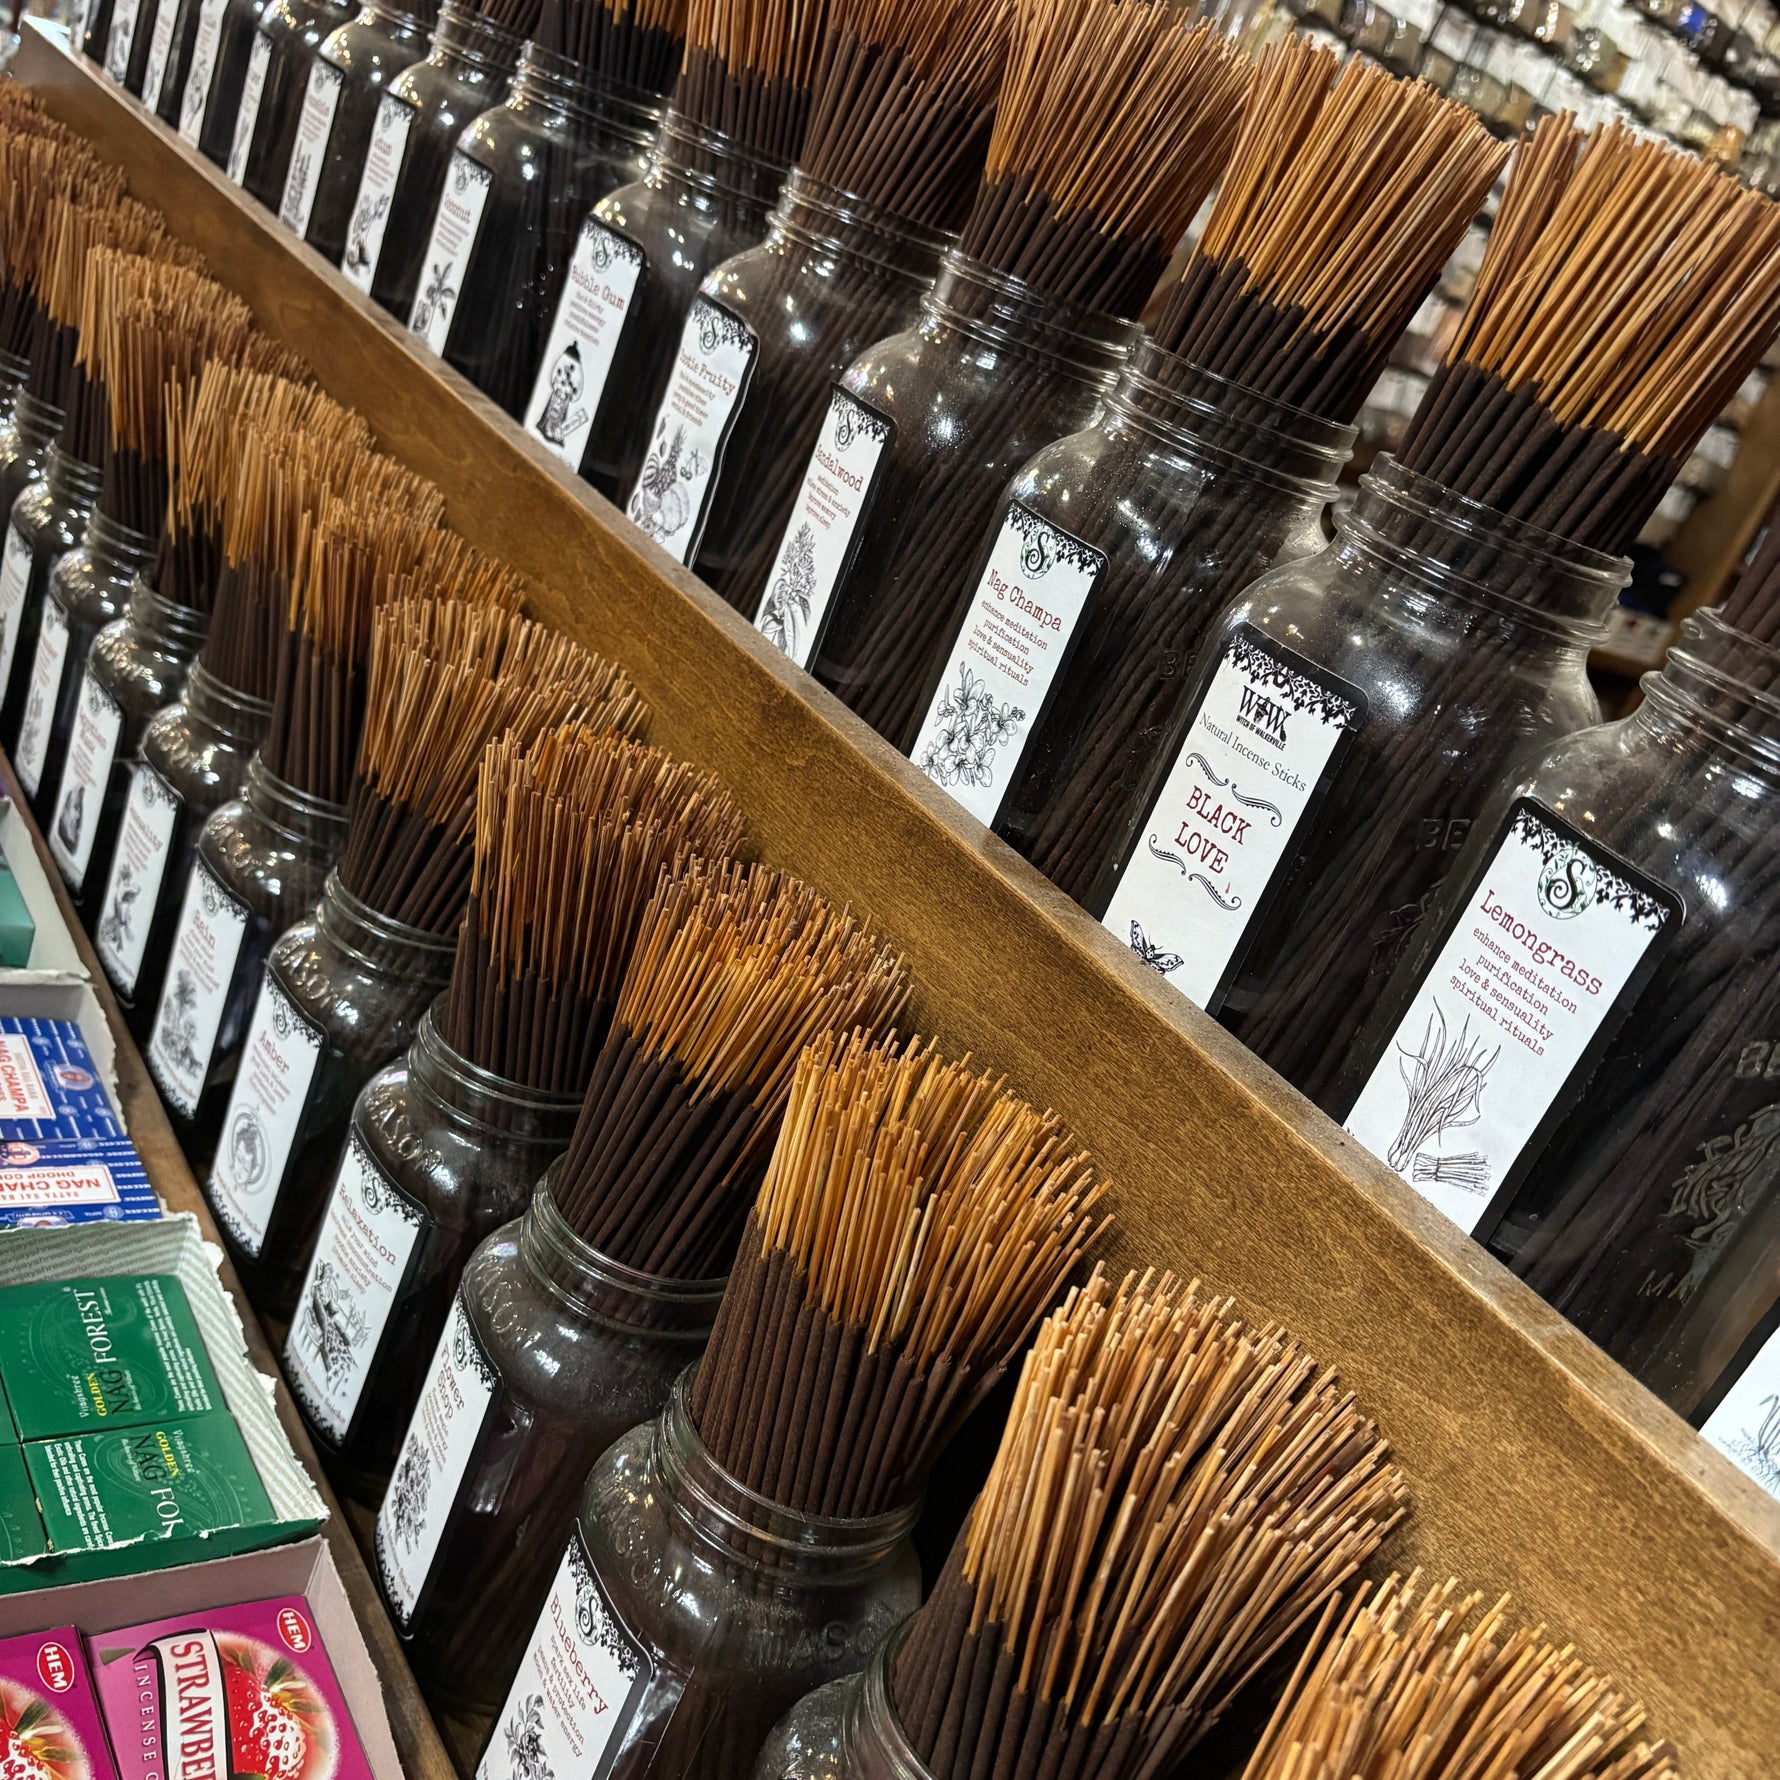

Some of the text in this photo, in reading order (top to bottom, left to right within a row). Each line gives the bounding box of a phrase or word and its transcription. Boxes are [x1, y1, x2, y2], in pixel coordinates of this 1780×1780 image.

[603, 286, 624, 310] Gum
[699, 363, 735, 396] Fruity
[815, 444, 863, 492] Sandalwood
[981, 600, 1048, 650] enhance meditation
[987, 568, 1062, 632] Nag Champa
[973, 624, 1034, 674] love & sensuality
[983, 619, 1029, 655] purification
[967, 639, 1029, 687] spiritual rituals
[1199, 712, 1231, 745] Natural
[1231, 735, 1271, 771] Incense
[1271, 762, 1307, 793] Sticks
[1255, 727, 1286, 751] WALKERVILLE
[1186, 785, 1252, 845] BLACK
[1174, 821, 1229, 874] LOVE
[1480, 889, 1603, 995] Lemongrass
[1473, 926, 1577, 1014] enhance meditation
[1476, 954, 1548, 1016] purification
[1450, 974, 1544, 1056] spiritual rituals
[1459, 958, 1554, 1041] love & sensuality
[260, 1030, 290, 1074] Amber
[1, 1065, 29, 1112] CHAMPA
[56, 1178, 101, 1189] NAG
[339, 1182, 397, 1266] Relaxation
[72, 1286, 116, 1364] FOREST
[85, 1372, 108, 1416] GOLDEN
[98, 1369, 133, 1414] NAG
[438, 1370, 454, 1419] Shop
[441, 1341, 464, 1410] Flower
[129, 1433, 167, 1481] NAG
[154, 1430, 179, 1476] GOLDEN
[282, 1611, 306, 1650] HEM
[550, 1592, 608, 1715] Blueberry
[44, 1647, 68, 1689] HEM
[550, 1635, 586, 1710] spark sex life
[551, 1656, 576, 1709] fertility
[134, 1663, 157, 1762] INCENSE
[552, 1685, 584, 1744] protection
[560, 1719, 583, 1758] energy
